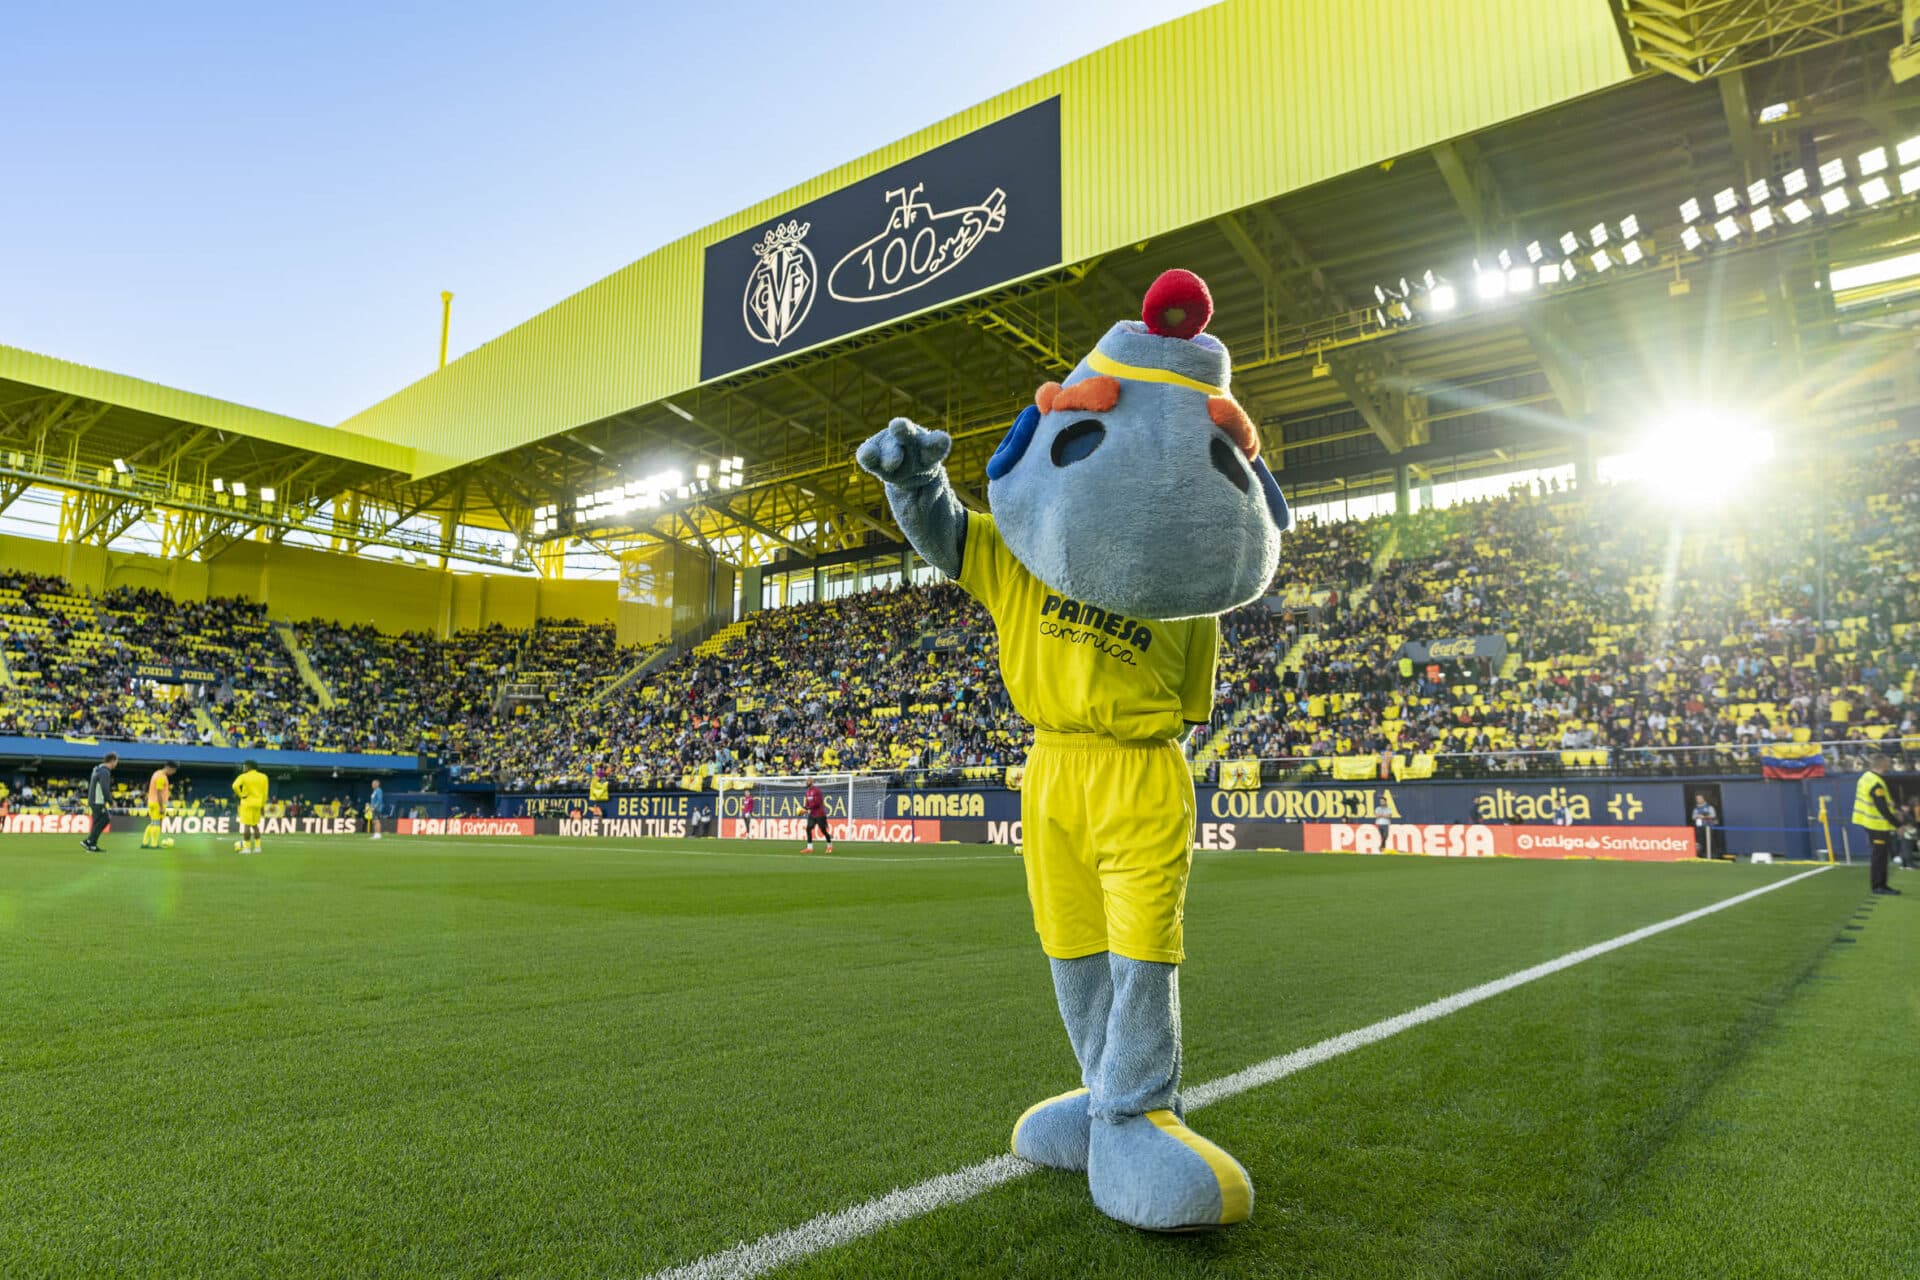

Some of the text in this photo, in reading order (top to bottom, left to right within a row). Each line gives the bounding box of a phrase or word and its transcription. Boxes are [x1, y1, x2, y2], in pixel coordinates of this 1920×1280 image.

[862, 227, 936, 290] 100
[1041, 595, 1152, 653] PAMESA
[1429, 639, 1476, 657] Coca-Cola
[618, 797, 688, 816] BESTILE
[715, 795, 847, 817] POCELANSA
[897, 793, 984, 817] PAMESA
[1479, 787, 1591, 819] altadia
[161, 816, 229, 834] MORE
[302, 818, 356, 834] TILES
[412, 818, 461, 834] PASA
[559, 818, 686, 838] MORE THAN TILES
[1330, 824, 1689, 857] PAMESA LaLiga Santander
